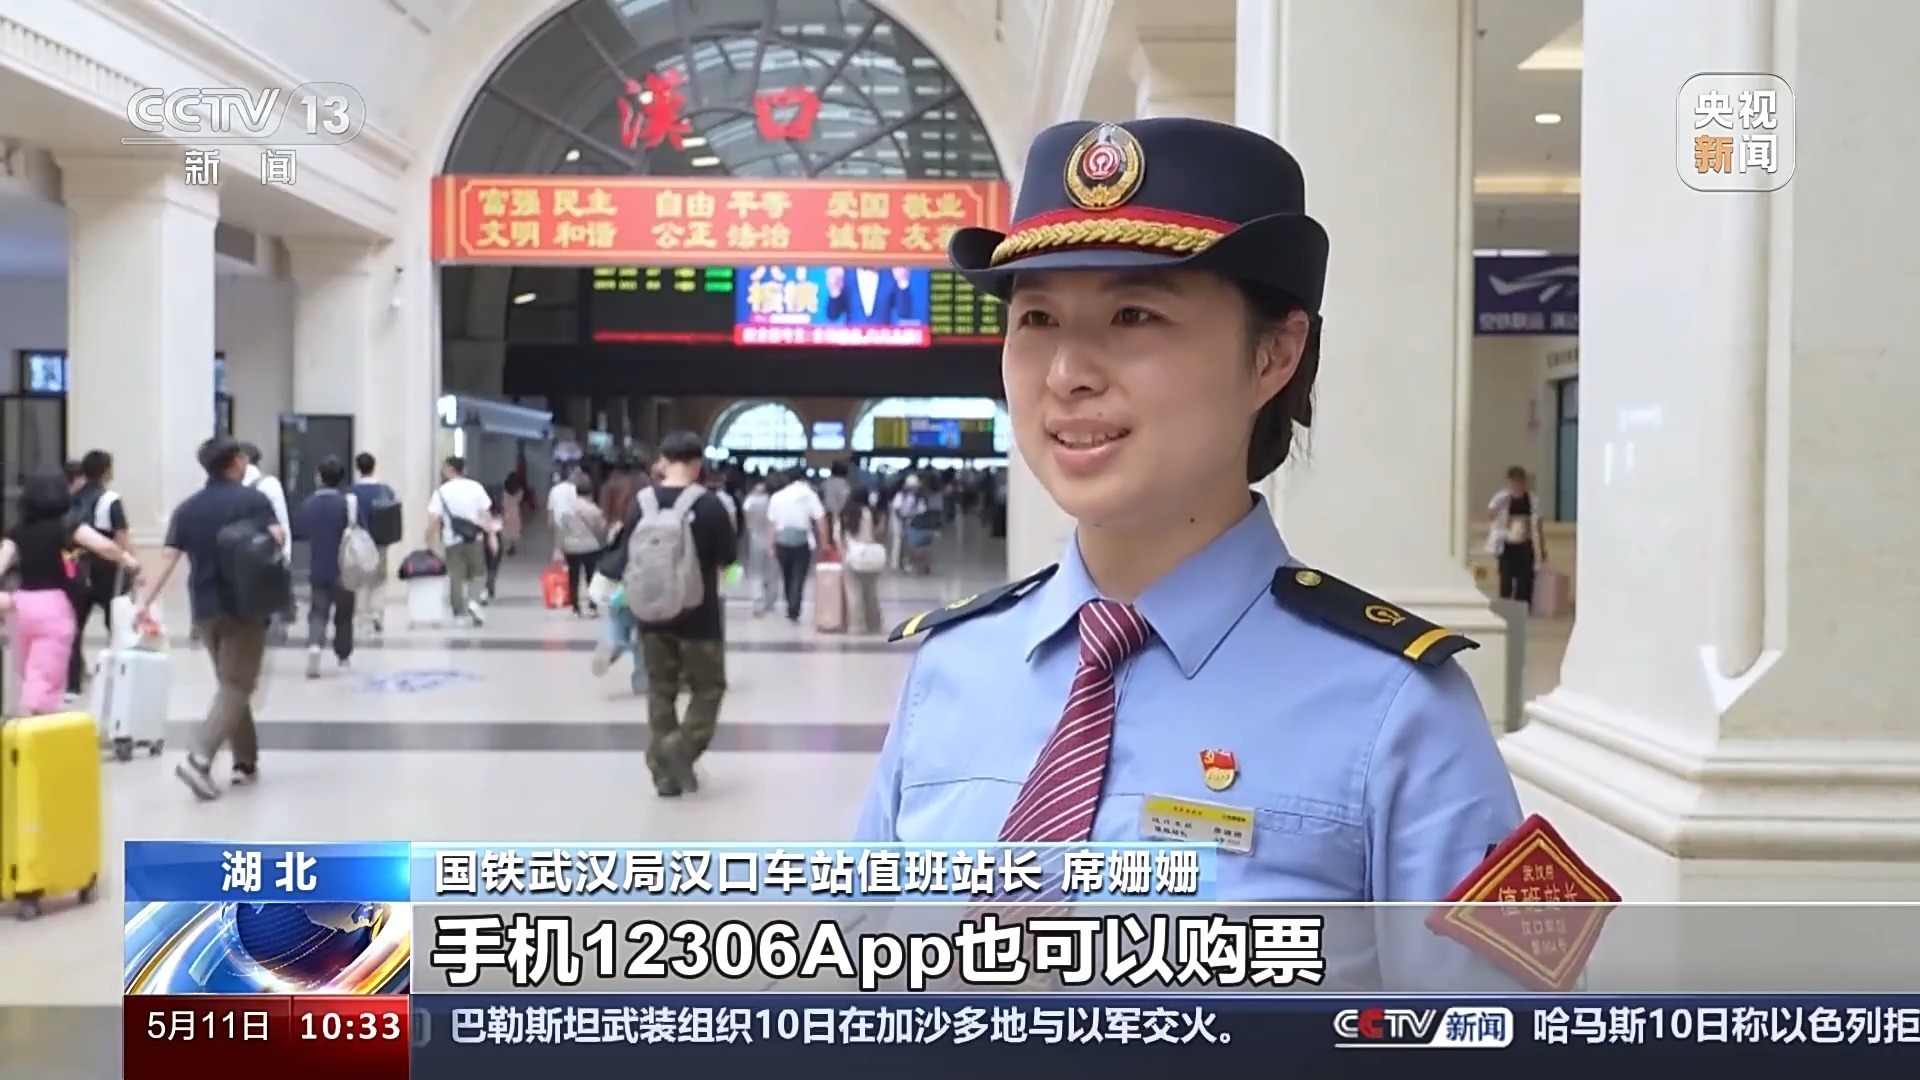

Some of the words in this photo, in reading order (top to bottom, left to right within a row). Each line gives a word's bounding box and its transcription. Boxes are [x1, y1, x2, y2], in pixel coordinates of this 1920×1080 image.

[553, 188, 617, 217] 民主
[655, 189, 716, 218] 自由
[727, 191, 792, 219] 平等
[476, 220, 540, 248] 文明
[651, 221, 717, 249] 公正
